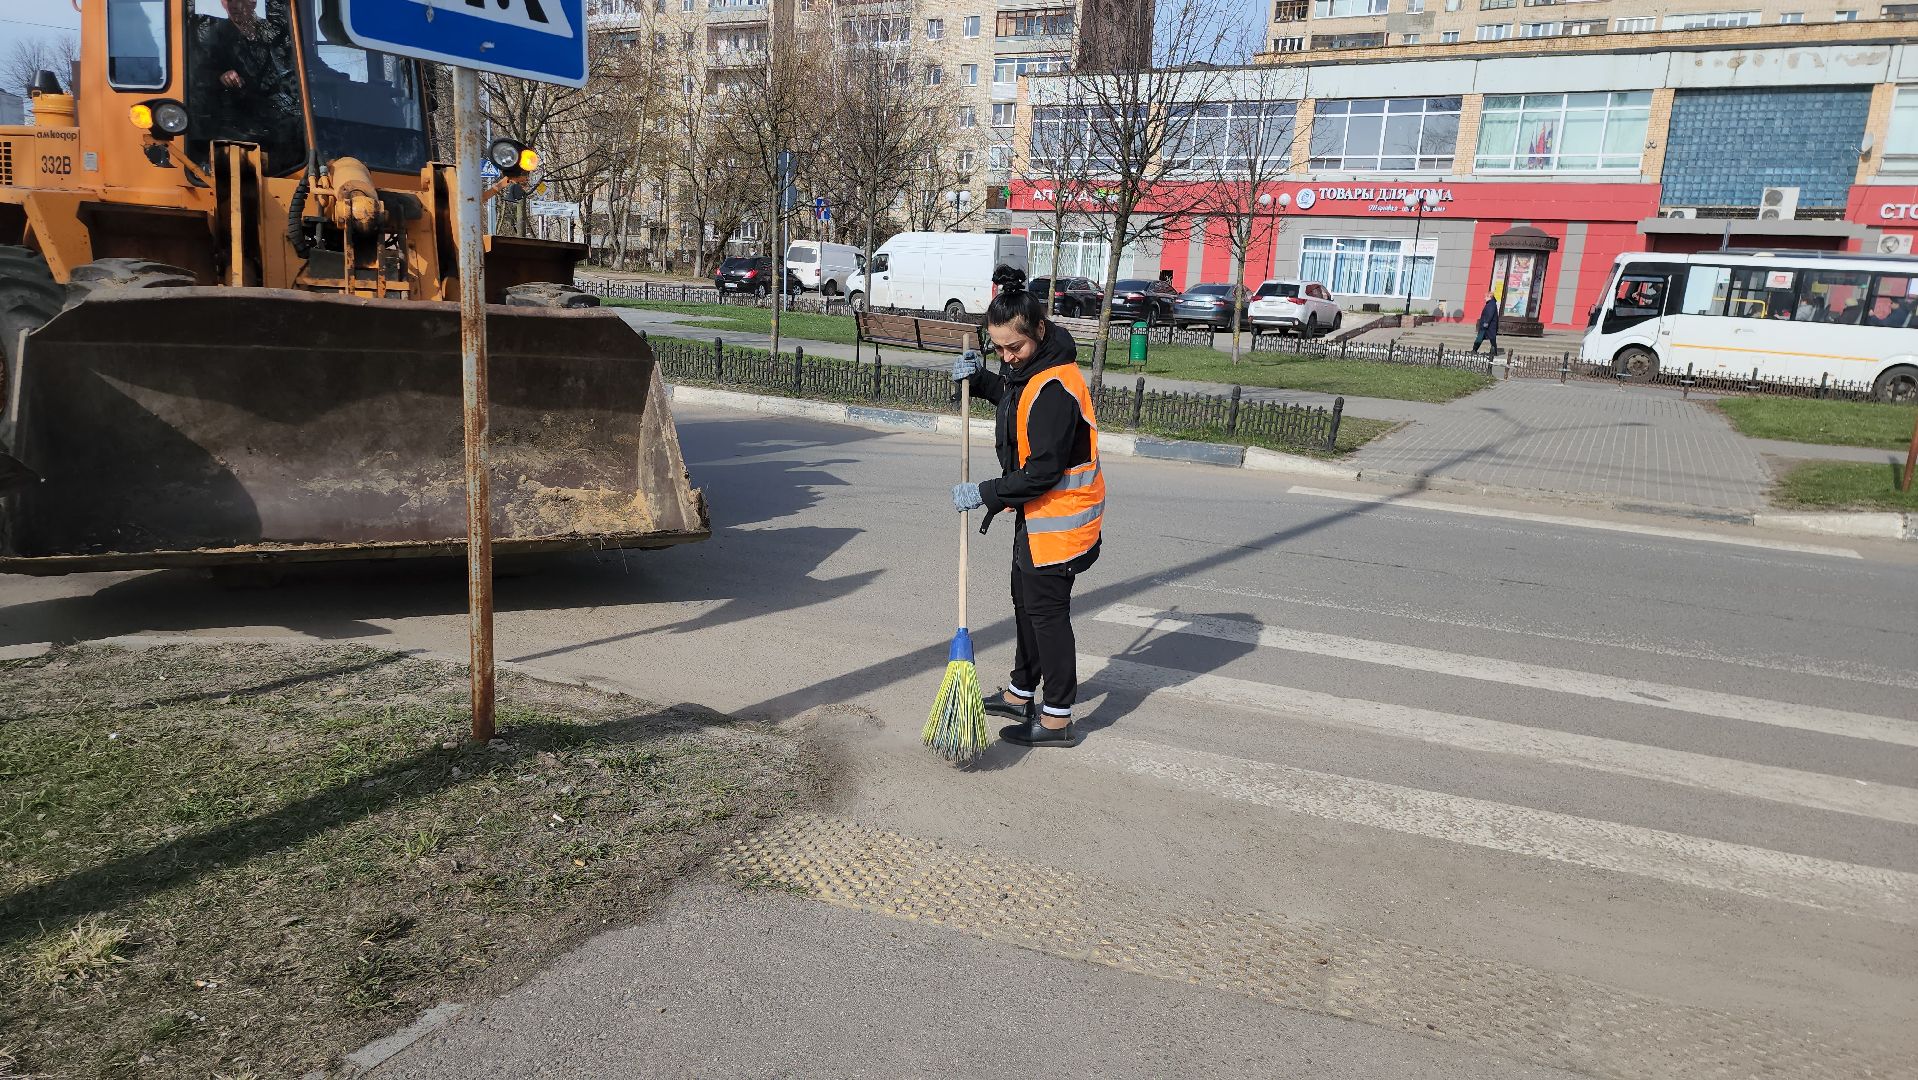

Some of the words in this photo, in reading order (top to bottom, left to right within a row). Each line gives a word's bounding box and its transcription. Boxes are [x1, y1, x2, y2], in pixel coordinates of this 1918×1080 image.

[1033, 189, 1089, 201] АПА
[1319, 187, 1375, 201] ТОВАРЫ
[1376, 187, 1408, 203] ДЛЯ
